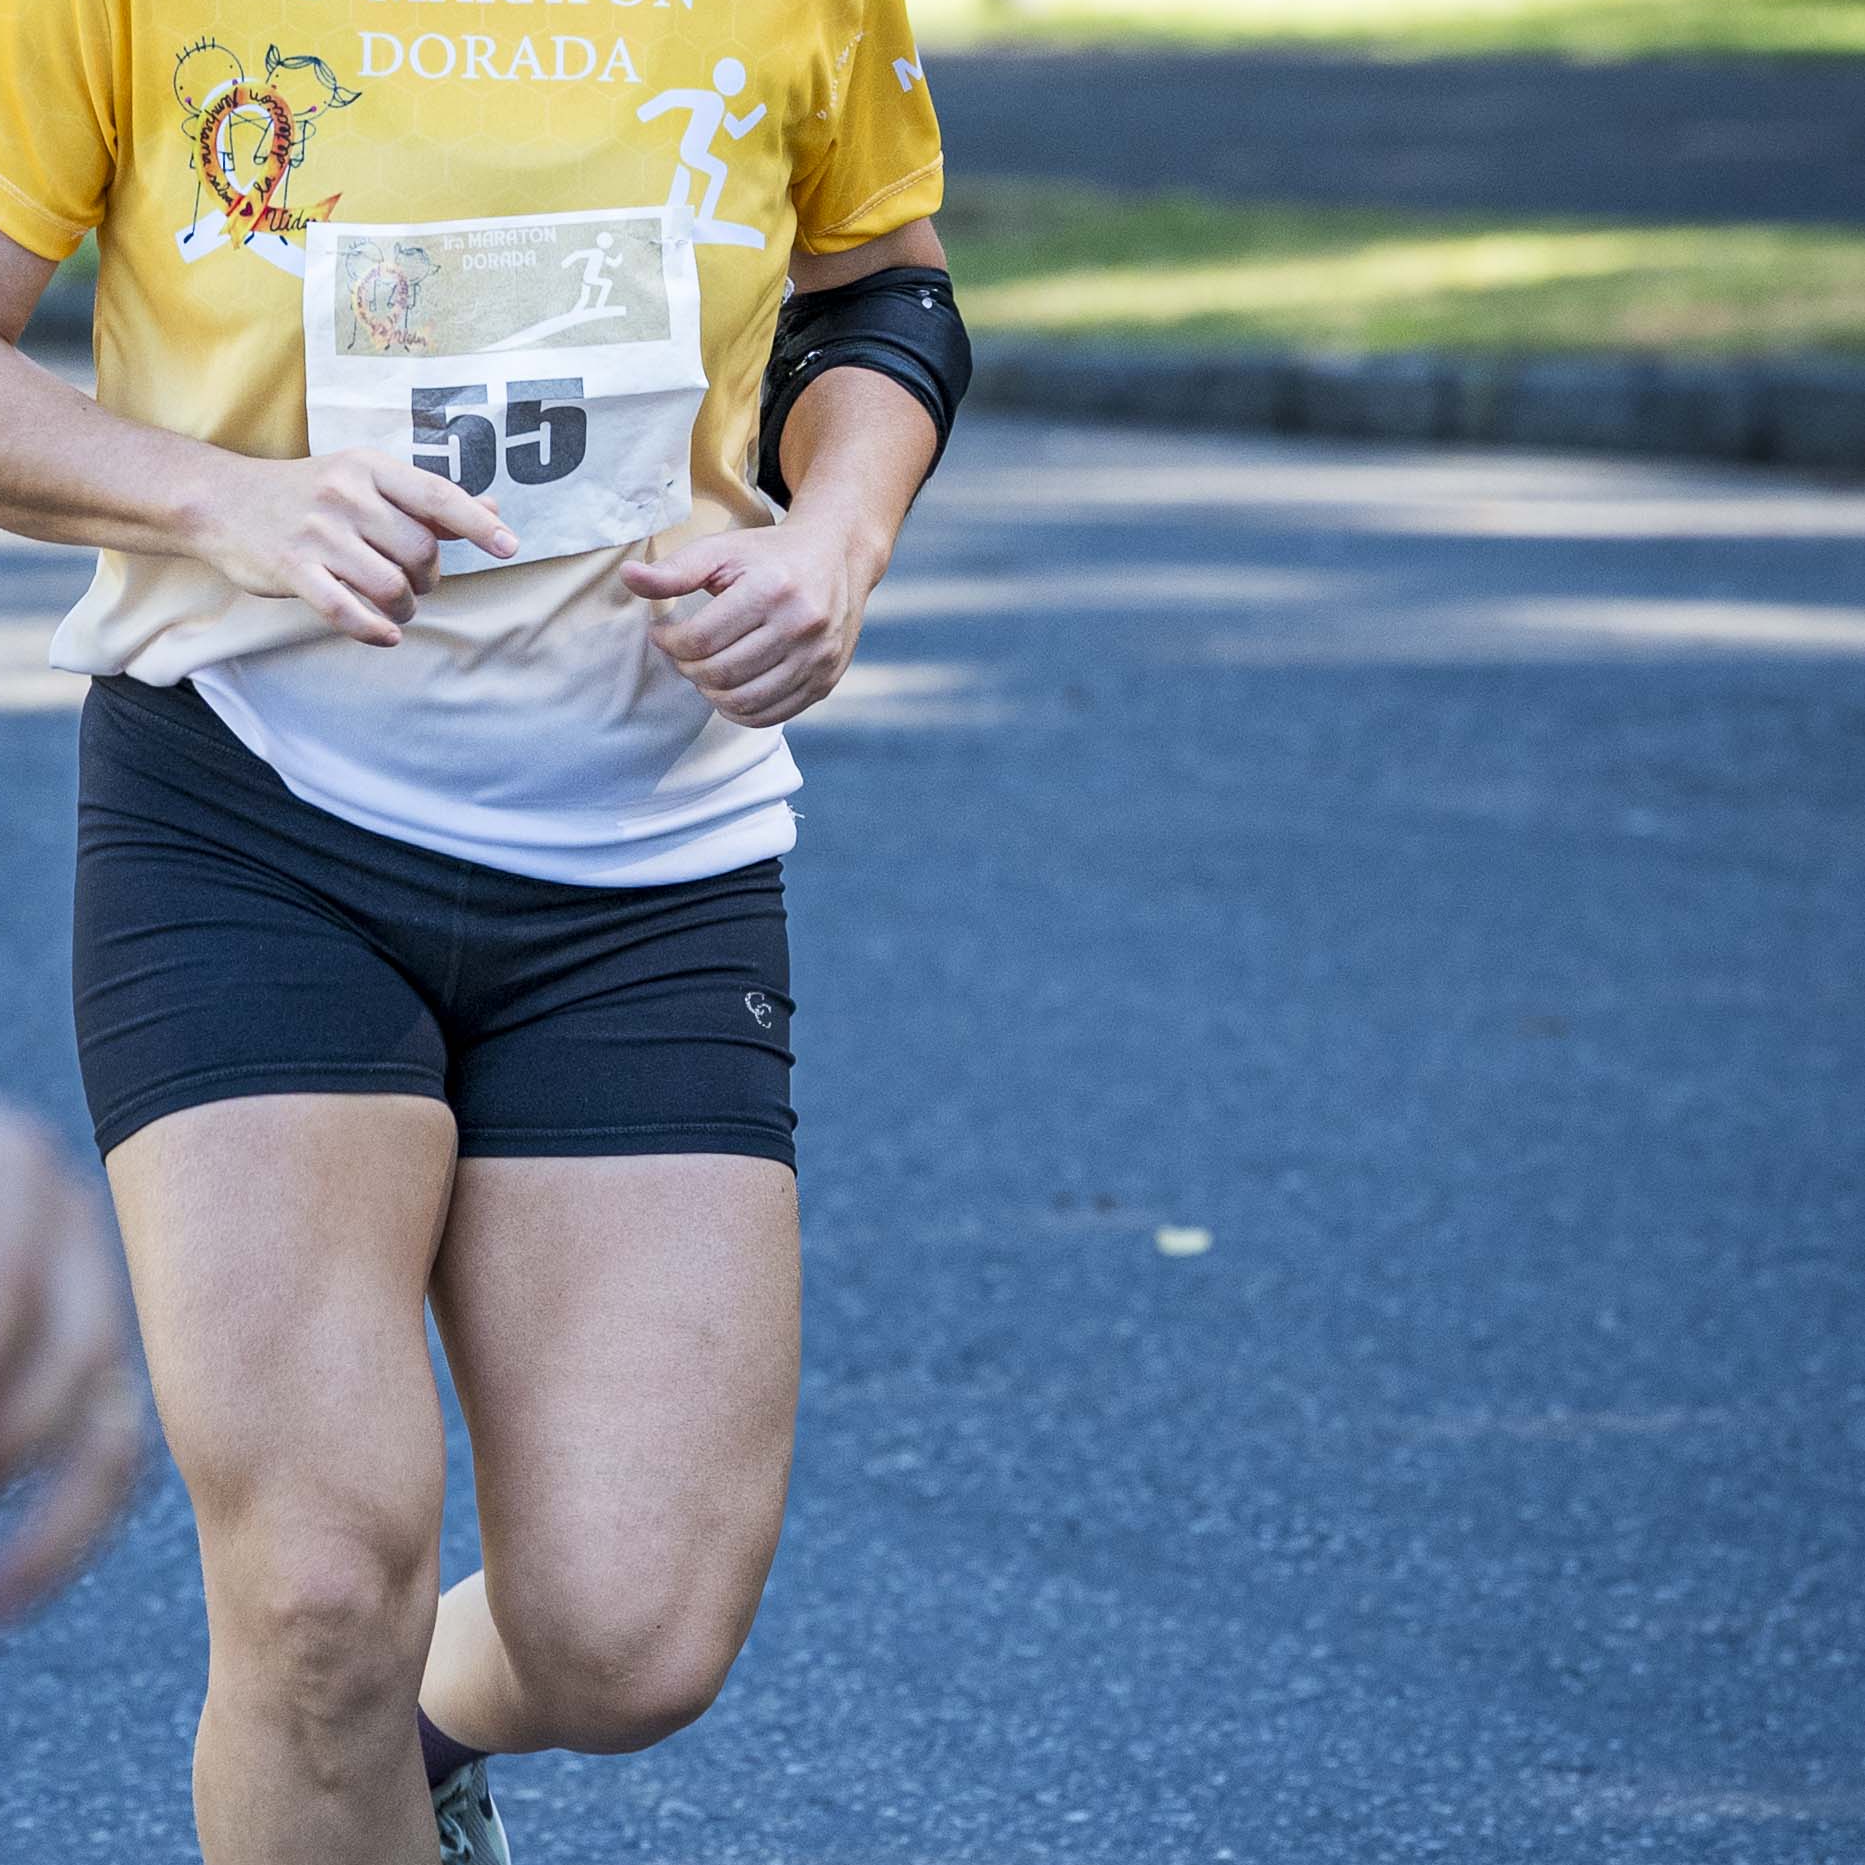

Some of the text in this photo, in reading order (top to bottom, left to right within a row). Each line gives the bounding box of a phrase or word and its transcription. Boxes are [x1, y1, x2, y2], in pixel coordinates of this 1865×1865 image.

[358, 32, 642, 83] DORADA
[462, 249, 537, 271] DORADA
[411, 376, 587, 497] 55
